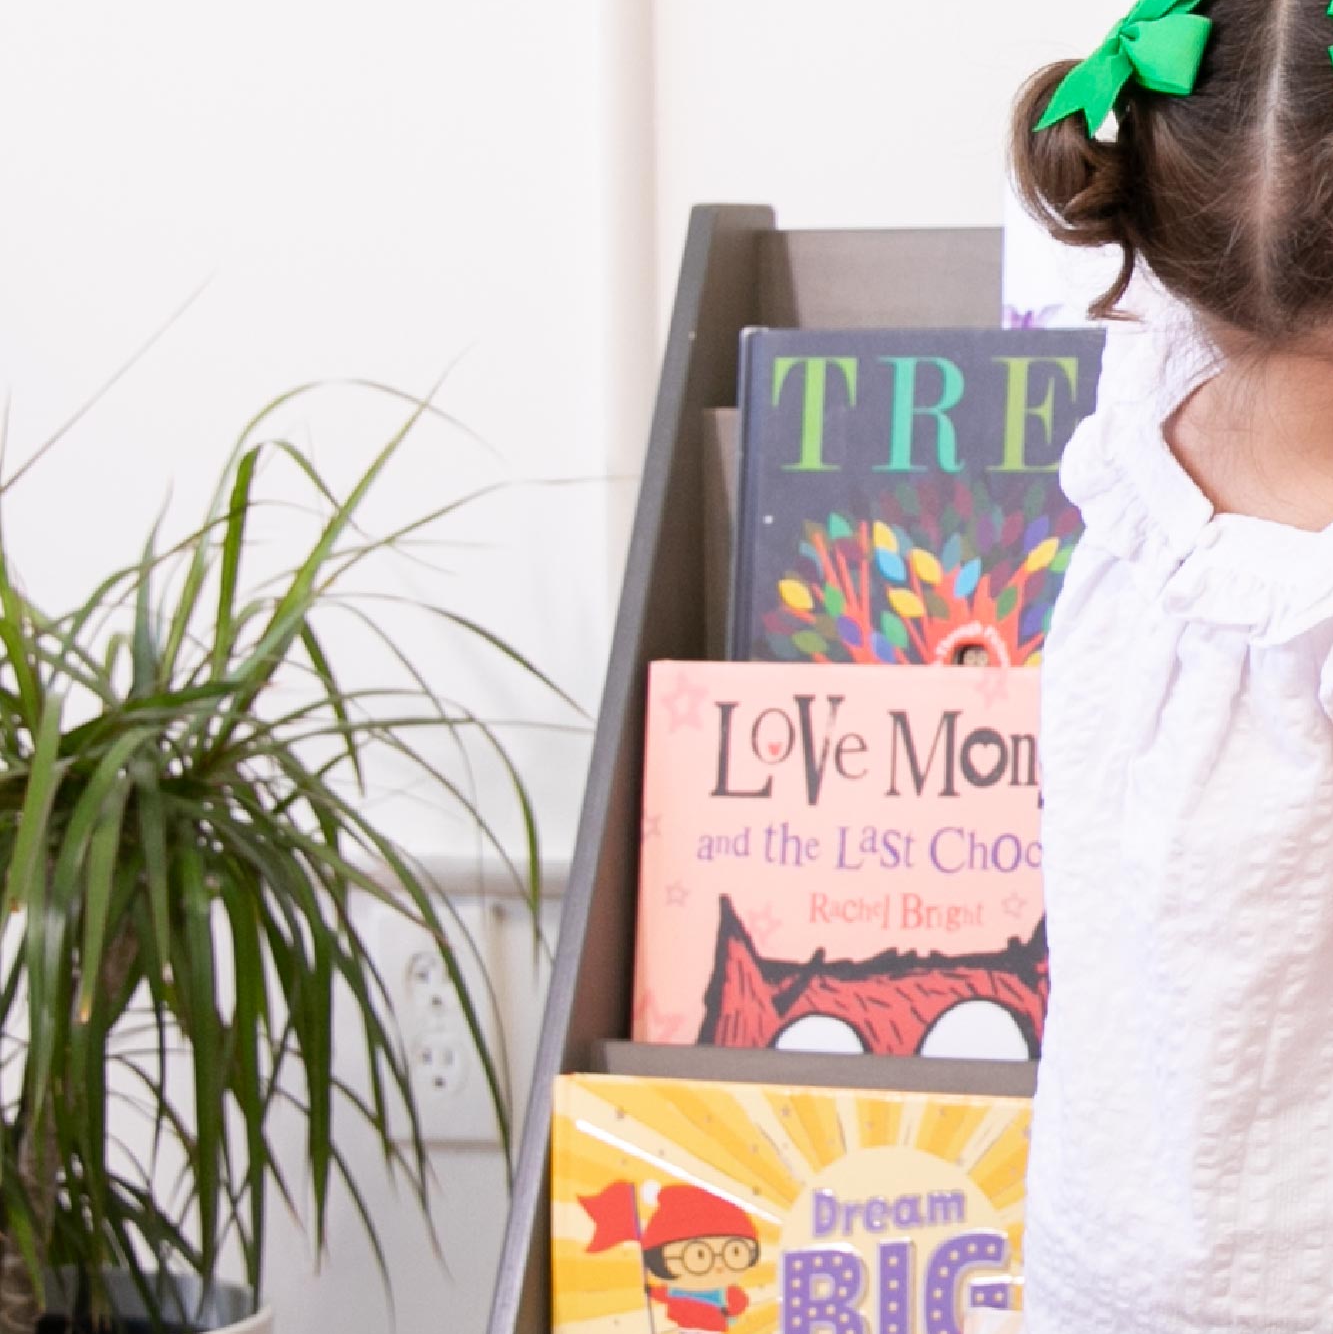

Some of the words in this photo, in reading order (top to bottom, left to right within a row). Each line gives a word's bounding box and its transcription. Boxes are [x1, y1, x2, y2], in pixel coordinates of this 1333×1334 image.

[885, 709, 1043, 809] Mon
[697, 827, 751, 861] and
[764, 823, 820, 865] the
[809, 892, 890, 930] Rachel
[900, 892, 985, 932] Bright
[811, 1188, 966, 1238] Dream
